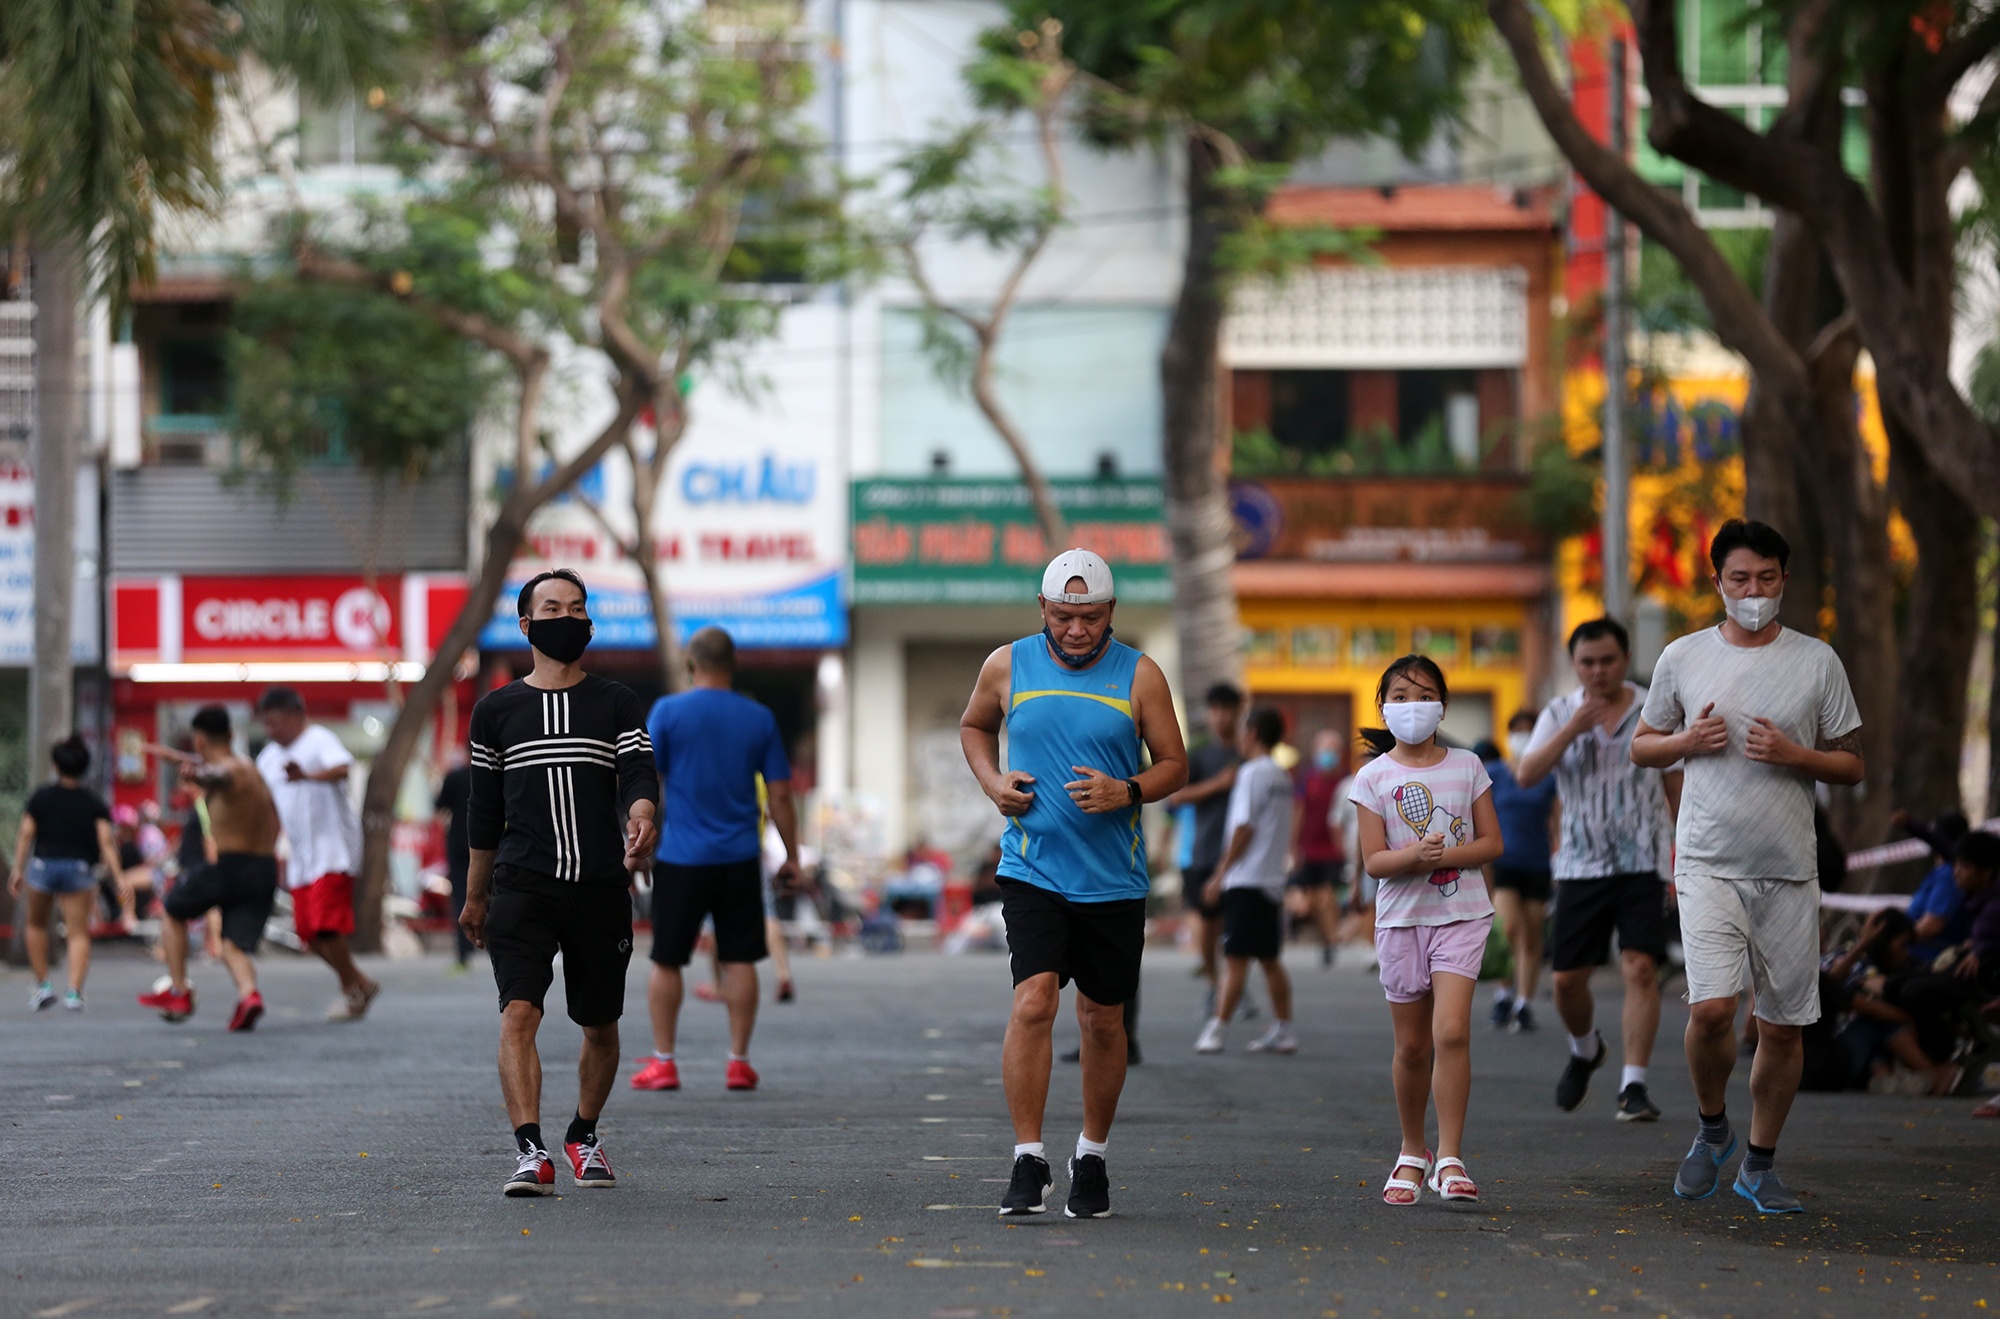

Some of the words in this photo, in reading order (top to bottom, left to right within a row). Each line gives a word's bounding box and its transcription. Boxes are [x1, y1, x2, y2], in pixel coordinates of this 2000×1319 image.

[681, 450, 816, 504] CHÂU
[701, 531, 814, 560] TRAVEL
[193, 597, 331, 641] CIRCLE
